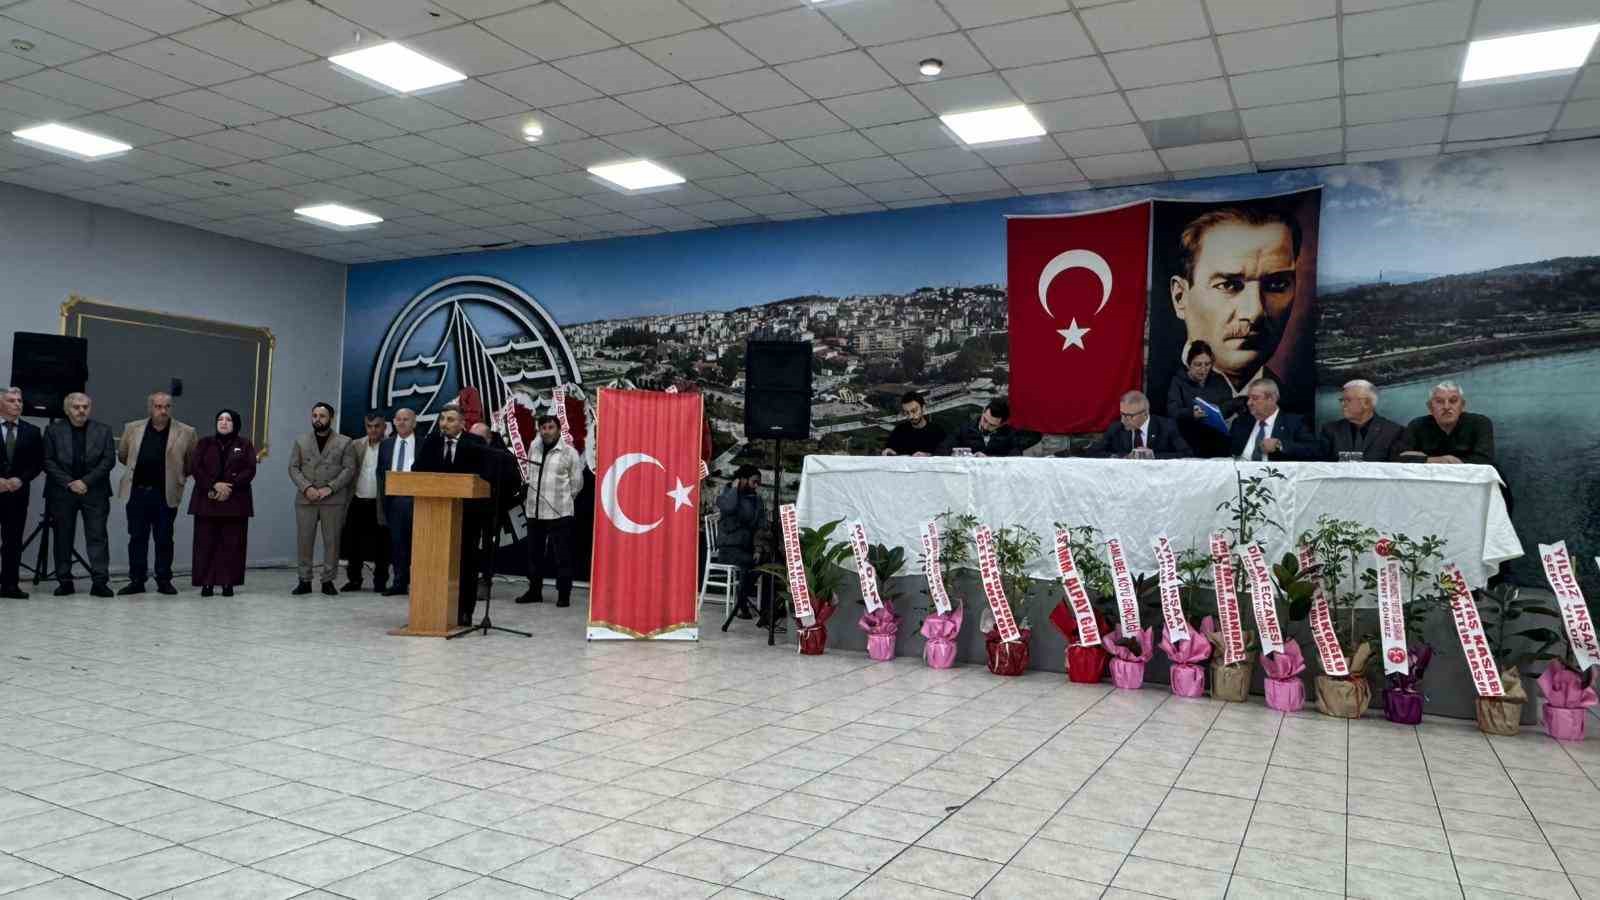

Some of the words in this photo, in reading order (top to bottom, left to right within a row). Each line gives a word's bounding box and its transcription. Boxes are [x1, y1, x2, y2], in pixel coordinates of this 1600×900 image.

[788, 511, 800, 561] ULUKAYA
[795, 563, 809, 612] TİCARET
[1117, 576, 1133, 597] KÖYÜ
[1158, 536, 1176, 580] AYHAN
[1169, 584, 1186, 634] İNŞAAT
[1553, 547, 1580, 598] YILDIZ
[985, 581, 1010, 639] MOTOR
[991, 570, 1017, 635] KUNDURA
[1065, 577, 1090, 616] ALPAY
[1079, 616, 1098, 643] GÜN
[1121, 596, 1140, 632] GENÇLİĞİ
[1160, 587, 1175, 628] AKMAN
[1247, 545, 1269, 582] DİLAN
[1260, 585, 1281, 645] ECZANESİ
[1562, 603, 1582, 648] YILDIZ
[1472, 632, 1501, 696] KASABI
